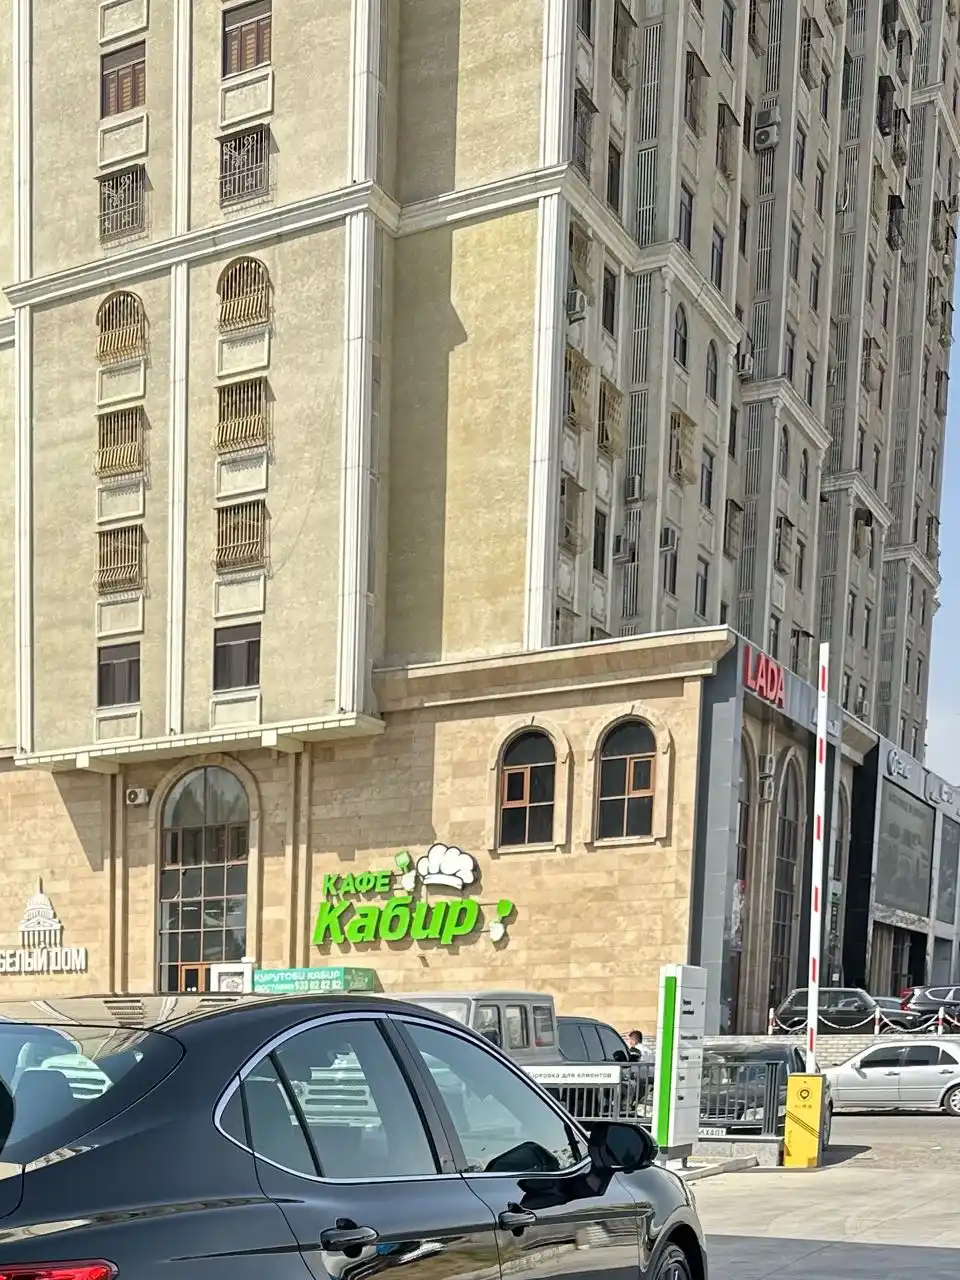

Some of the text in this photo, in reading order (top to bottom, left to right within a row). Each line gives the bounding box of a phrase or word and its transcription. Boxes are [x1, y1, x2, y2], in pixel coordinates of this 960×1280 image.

[743, 644, 785, 709] LADA
[322, 871, 390, 897] КАФЕ
[312, 895, 480, 945] Кабир
[49, 947, 87, 971] ДОМ
